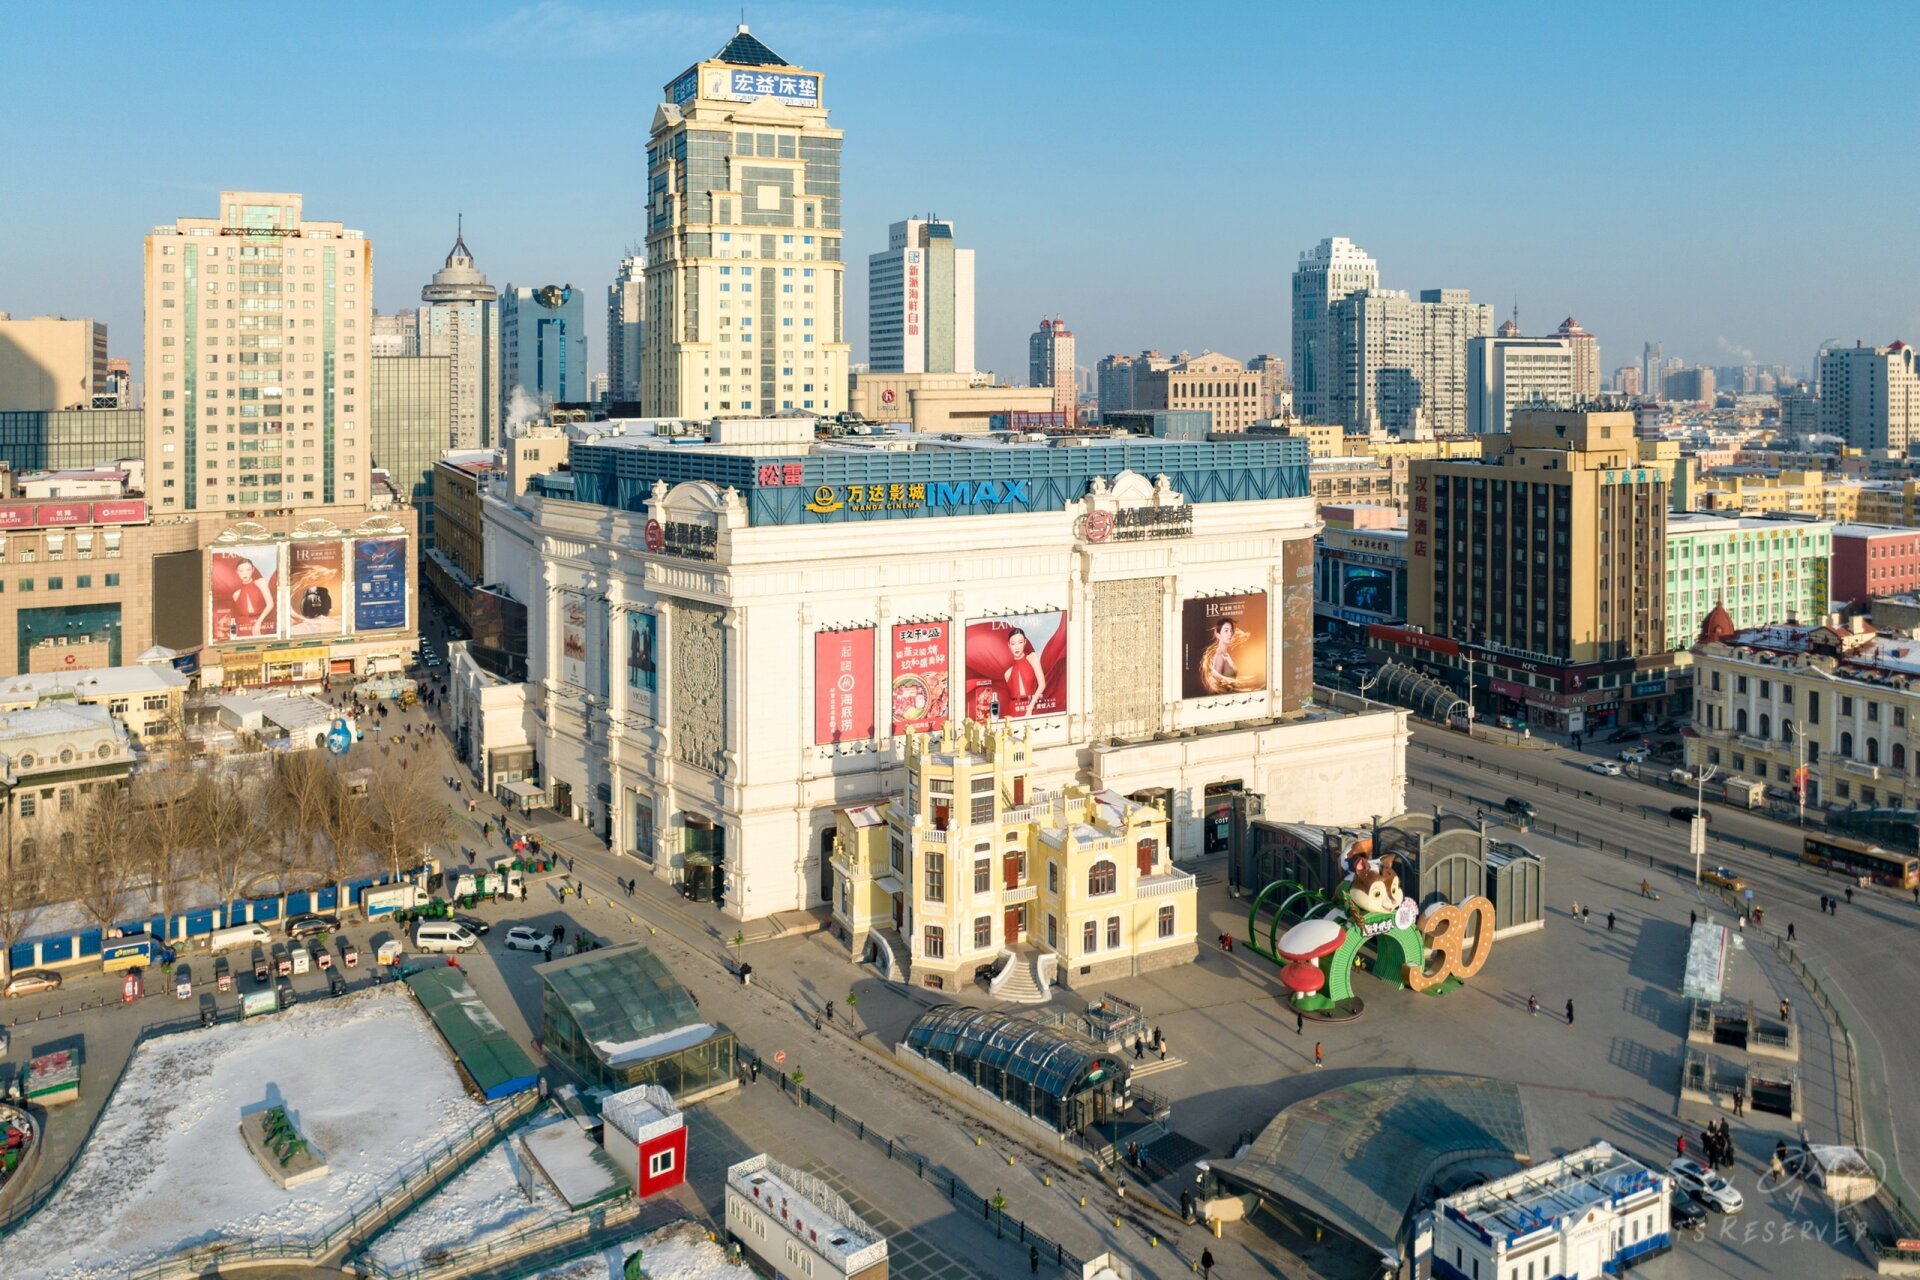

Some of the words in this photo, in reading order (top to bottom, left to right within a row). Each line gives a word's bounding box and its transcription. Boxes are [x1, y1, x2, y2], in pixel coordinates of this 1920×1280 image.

[735, 74, 816, 97] 宏益床垫
[758, 463, 803, 487] 松雷
[848, 483, 926, 503] 万达影城
[927, 479, 1029, 507] IMAX
[851, 503, 883, 512] WANDA
[886, 502, 921, 510] CINEMA
[1414, 475, 1427, 557] 汉庭酒店
[1206, 603, 1219, 616] HR
[1521, 661, 1538, 672] KFC
[1572, 695, 1586, 704] KFC
[841, 693, 853, 731] 海底捞
[1402, 895, 1495, 992] 30
